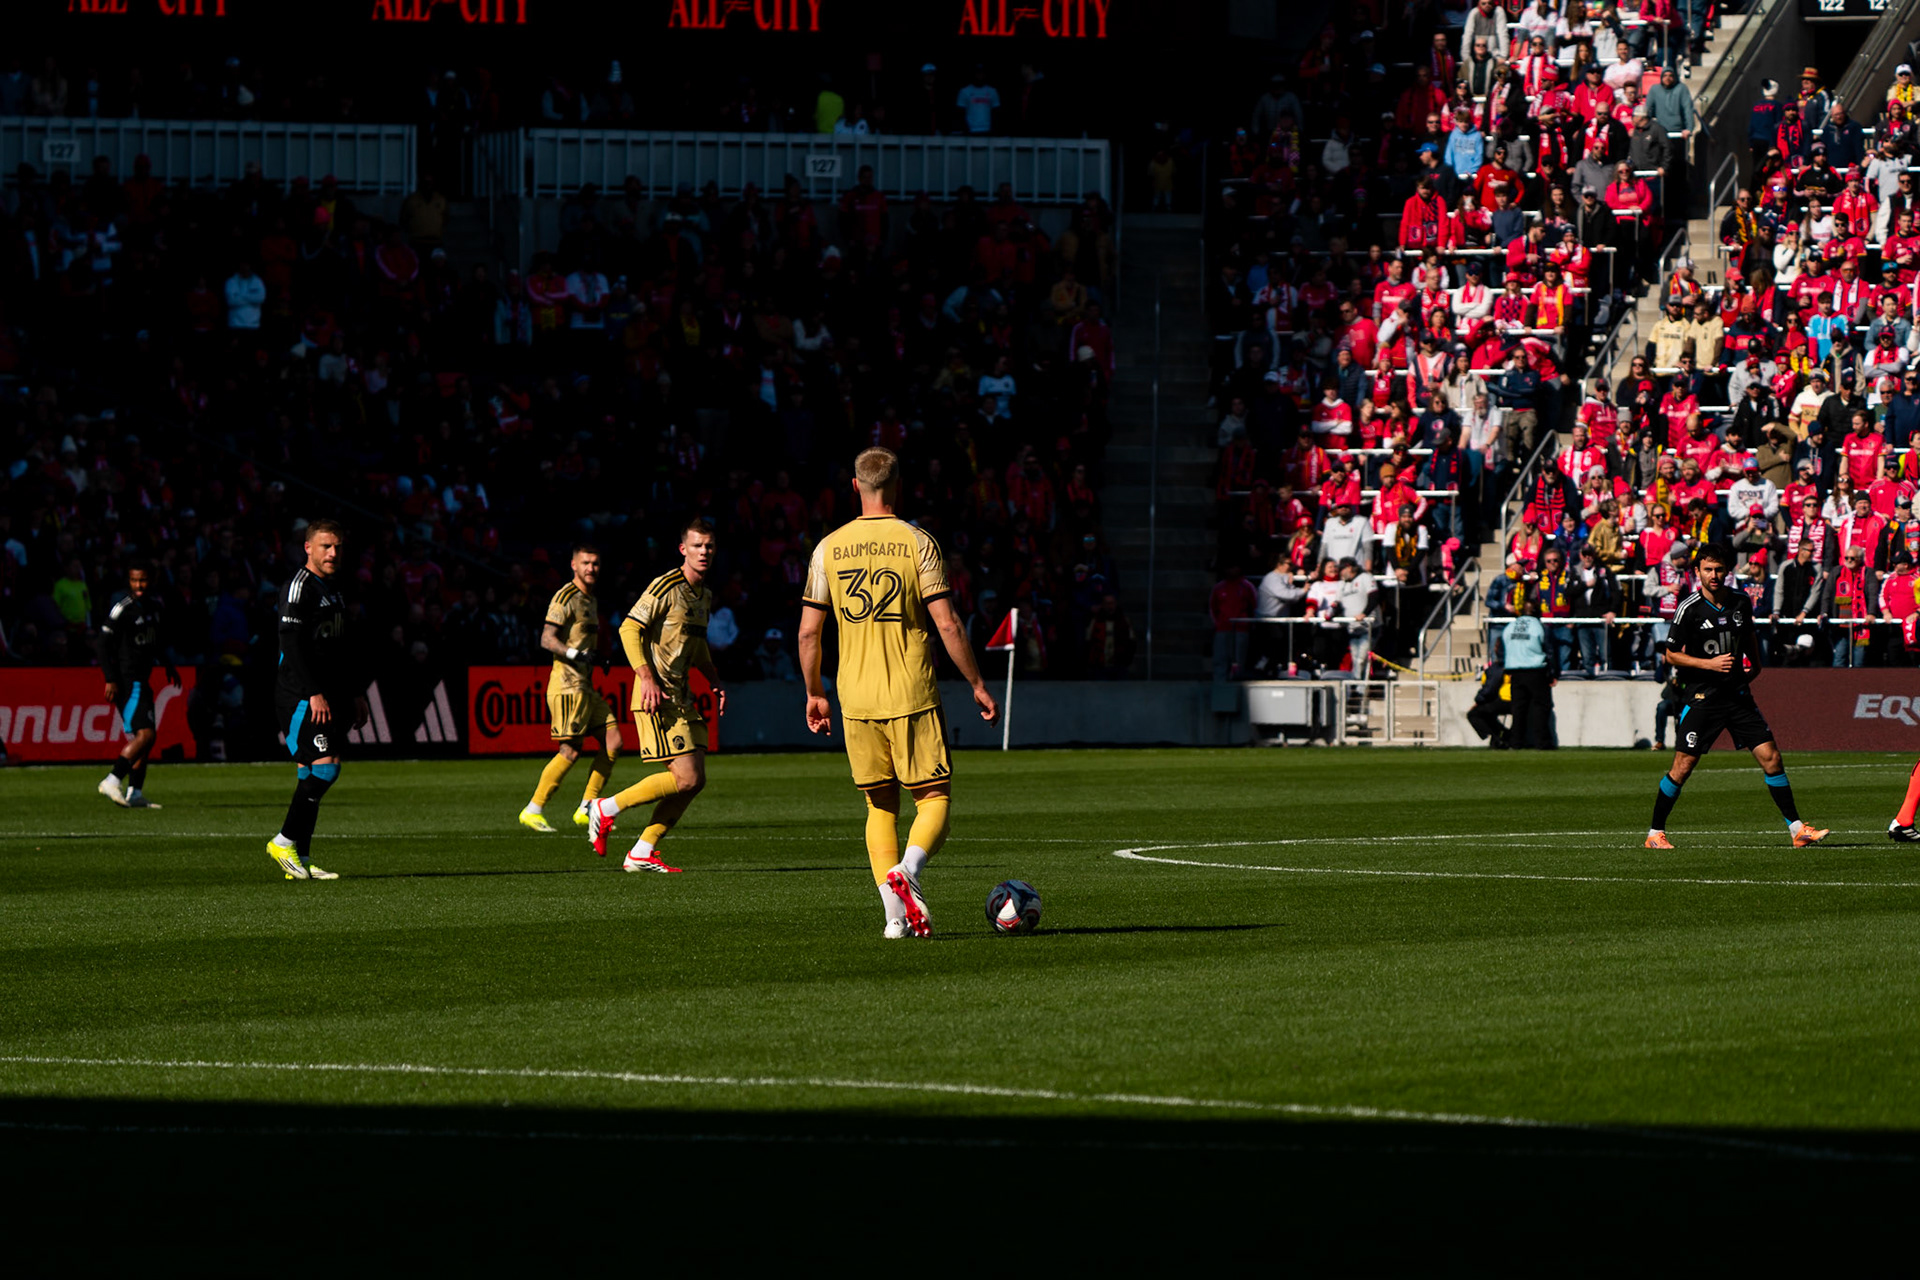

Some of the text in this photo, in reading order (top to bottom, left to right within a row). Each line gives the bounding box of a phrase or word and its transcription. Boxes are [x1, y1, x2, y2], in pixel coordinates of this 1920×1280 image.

[1819, 0, 1845, 11] 122
[49, 143, 75, 159] 127
[812, 159, 836, 173] 127
[833, 541, 911, 561] BAUMGARTL
[836, 567, 903, 624] 32
